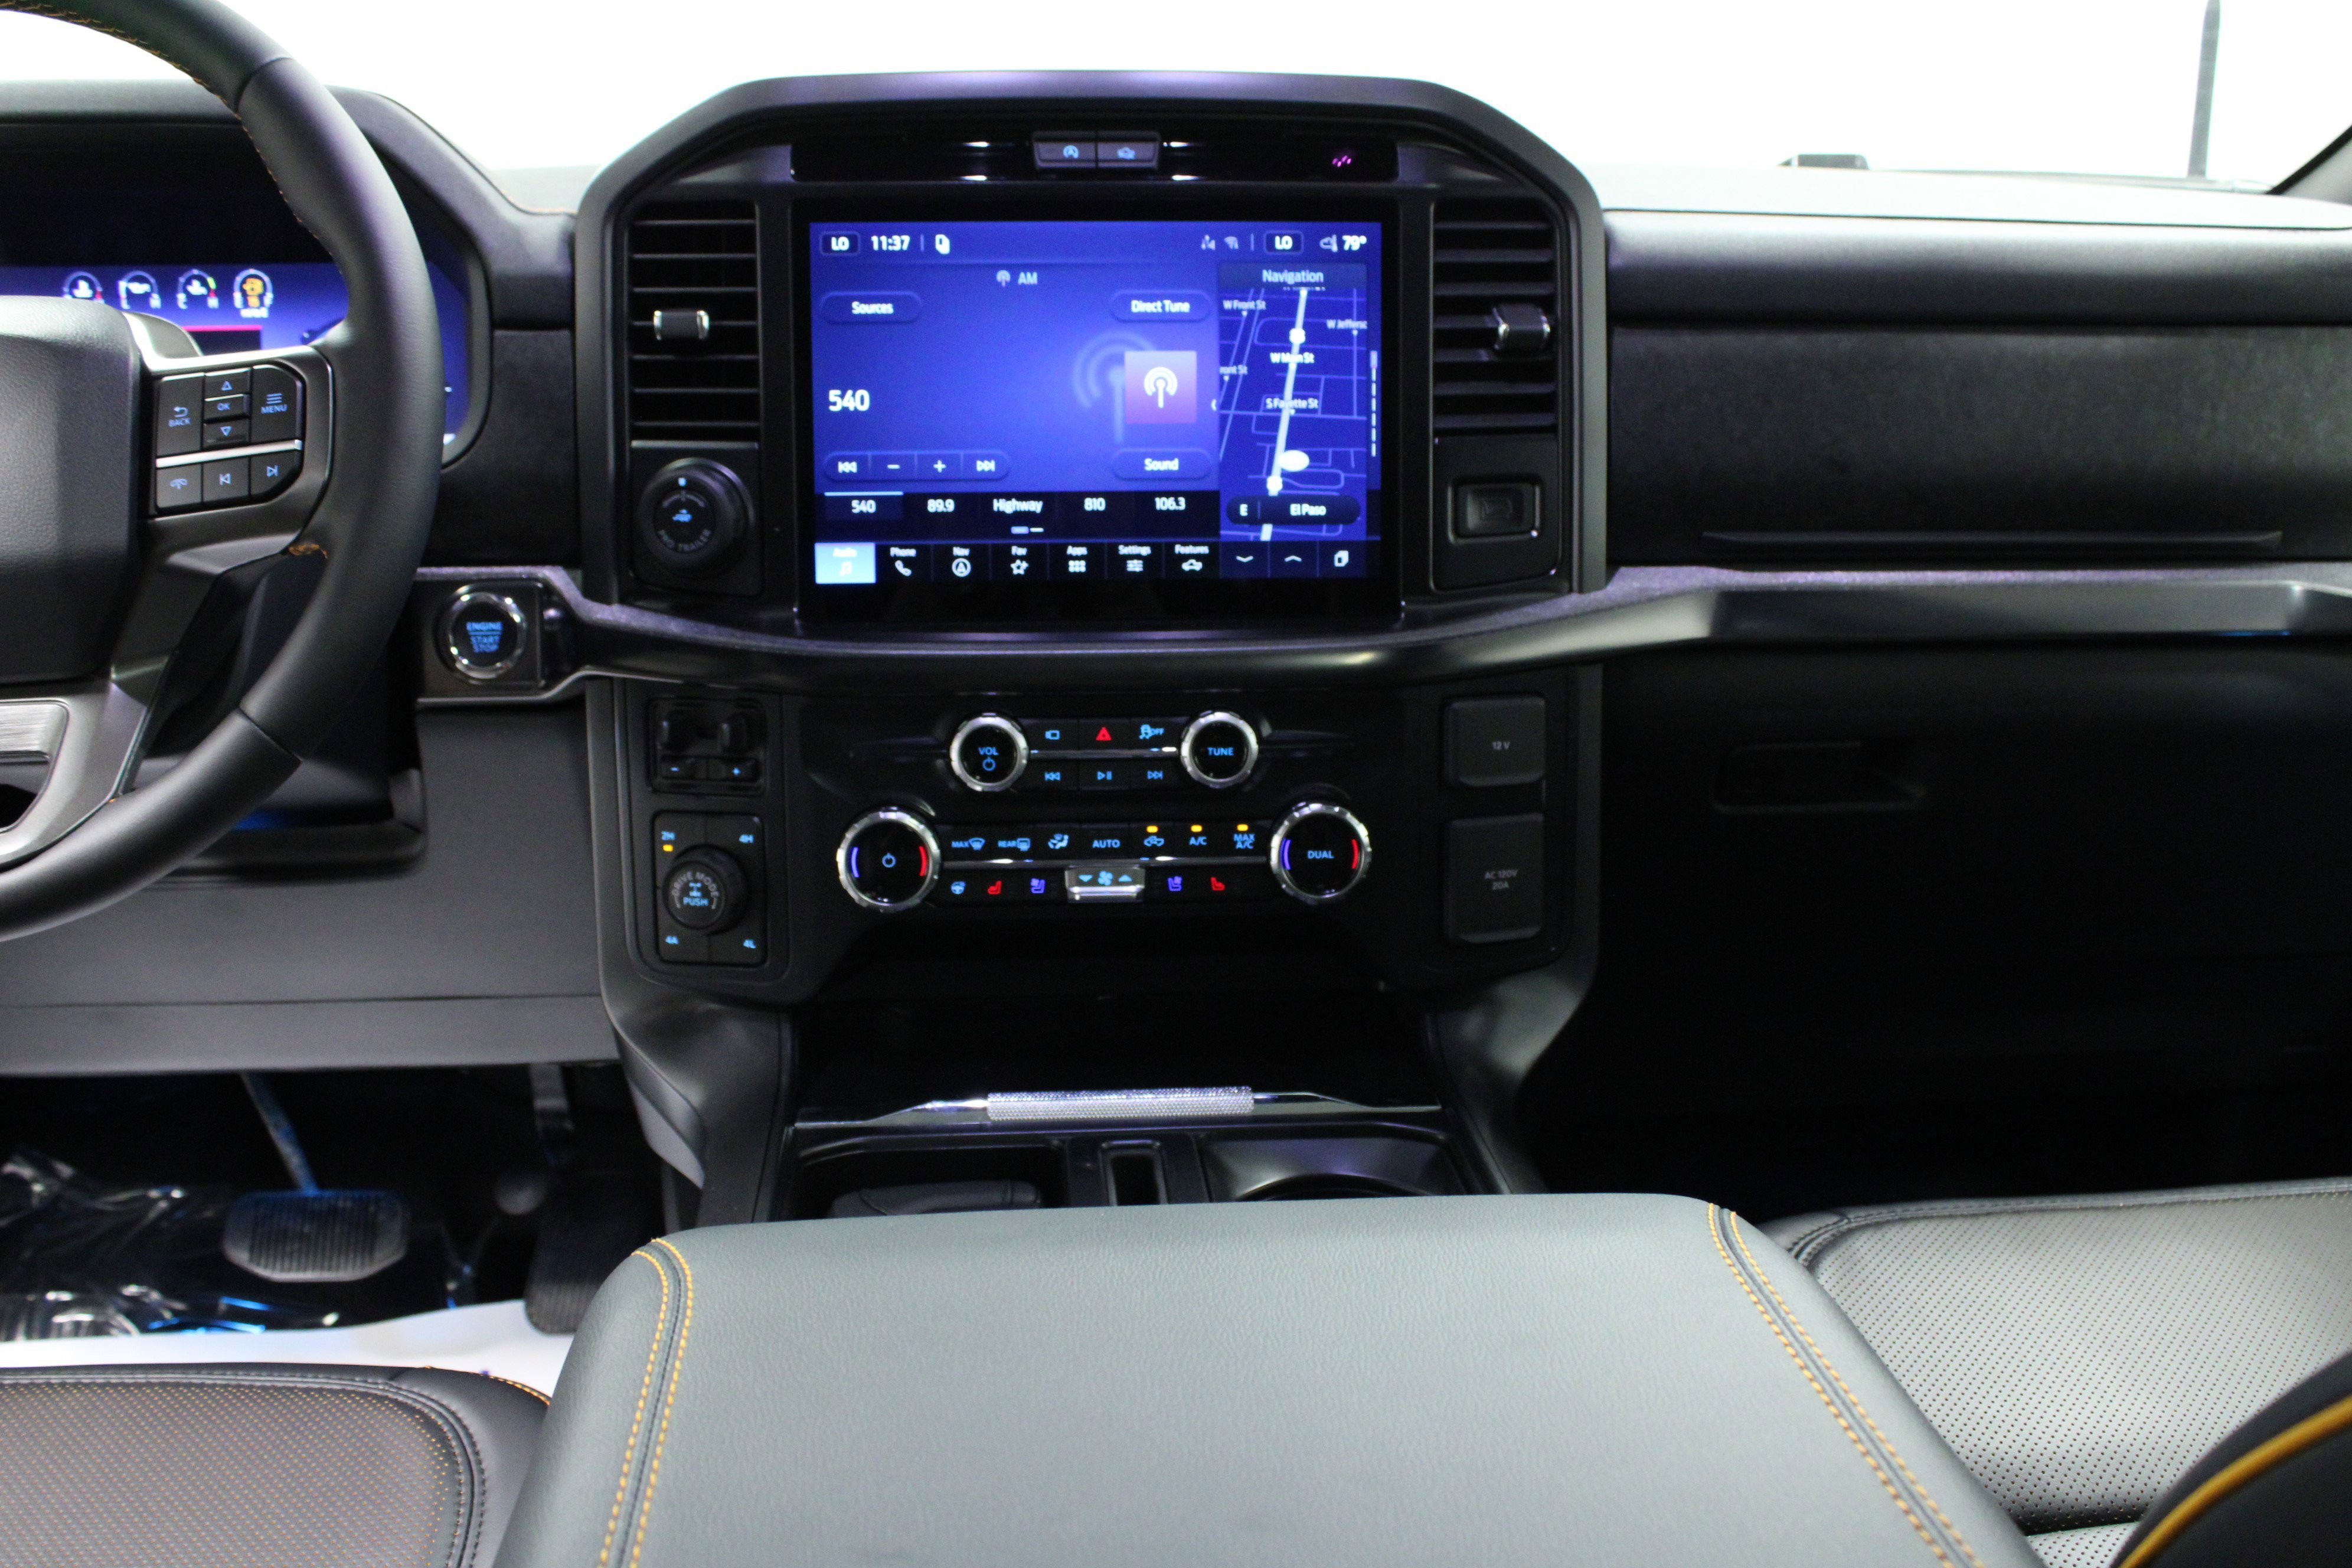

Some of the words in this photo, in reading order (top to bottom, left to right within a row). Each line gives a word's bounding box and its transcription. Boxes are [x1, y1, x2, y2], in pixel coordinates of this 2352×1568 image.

[831, 236, 850, 250] LO
[870, 235, 910, 250] 11:37
[1275, 236, 1292, 250] LO
[1342, 235, 1367, 251] 79°
[1018, 272, 1038, 285] AM
[1262, 270, 1324, 283] Navigation
[852, 300, 894, 315] Sources
[1131, 299, 1162, 313] Direct
[1164, 299, 1190, 313] Tune
[1223, 300, 1233, 310] W
[1256, 299, 1266, 310] St
[1270, 352, 1281, 363] W
[1303, 352, 1315, 363] St
[1237, 365, 1248, 374] St
[828, 389, 870, 411] 540
[1266, 397, 1273, 409] S
[1308, 397, 1319, 409] St
[217, 403, 231, 411] OK
[261, 404, 288, 414] MENU
[168, 417, 192, 427] BACK
[1145, 458, 1179, 472] Sound
[851, 499, 876, 514] 540
[927, 499, 955, 513] 89.9
[993, 498, 1043, 515] Highway
[1084, 498, 1106, 512] 810
[1155, 496, 1186, 512] 106.3
[1240, 503, 1249, 517] E
[1301, 503, 1327, 518] Paso
[890, 547, 917, 557] Phone
[953, 547, 970, 557] Nav
[1011, 546, 1028, 557] Fav
[1067, 546, 1087, 558] Apps
[1119, 545, 1152, 558] Settings
[1174, 544, 1209, 555] Features
[1151, 727, 1165, 736] OFF
[1492, 741, 1502, 750] 12
[1503, 741, 1510, 750] V
[978, 747, 999, 756] VOL
[1207, 747, 1234, 756] TUNE
[739, 834, 754, 844] 4H
[1092, 839, 1121, 848] AUTO
[1189, 837, 1207, 845] A/C
[1236, 841, 1254, 850] A/C
[1307, 850, 1334, 859] DUAL
[1485, 870, 1497, 880] AC
[683, 897, 709, 906] PUSH
